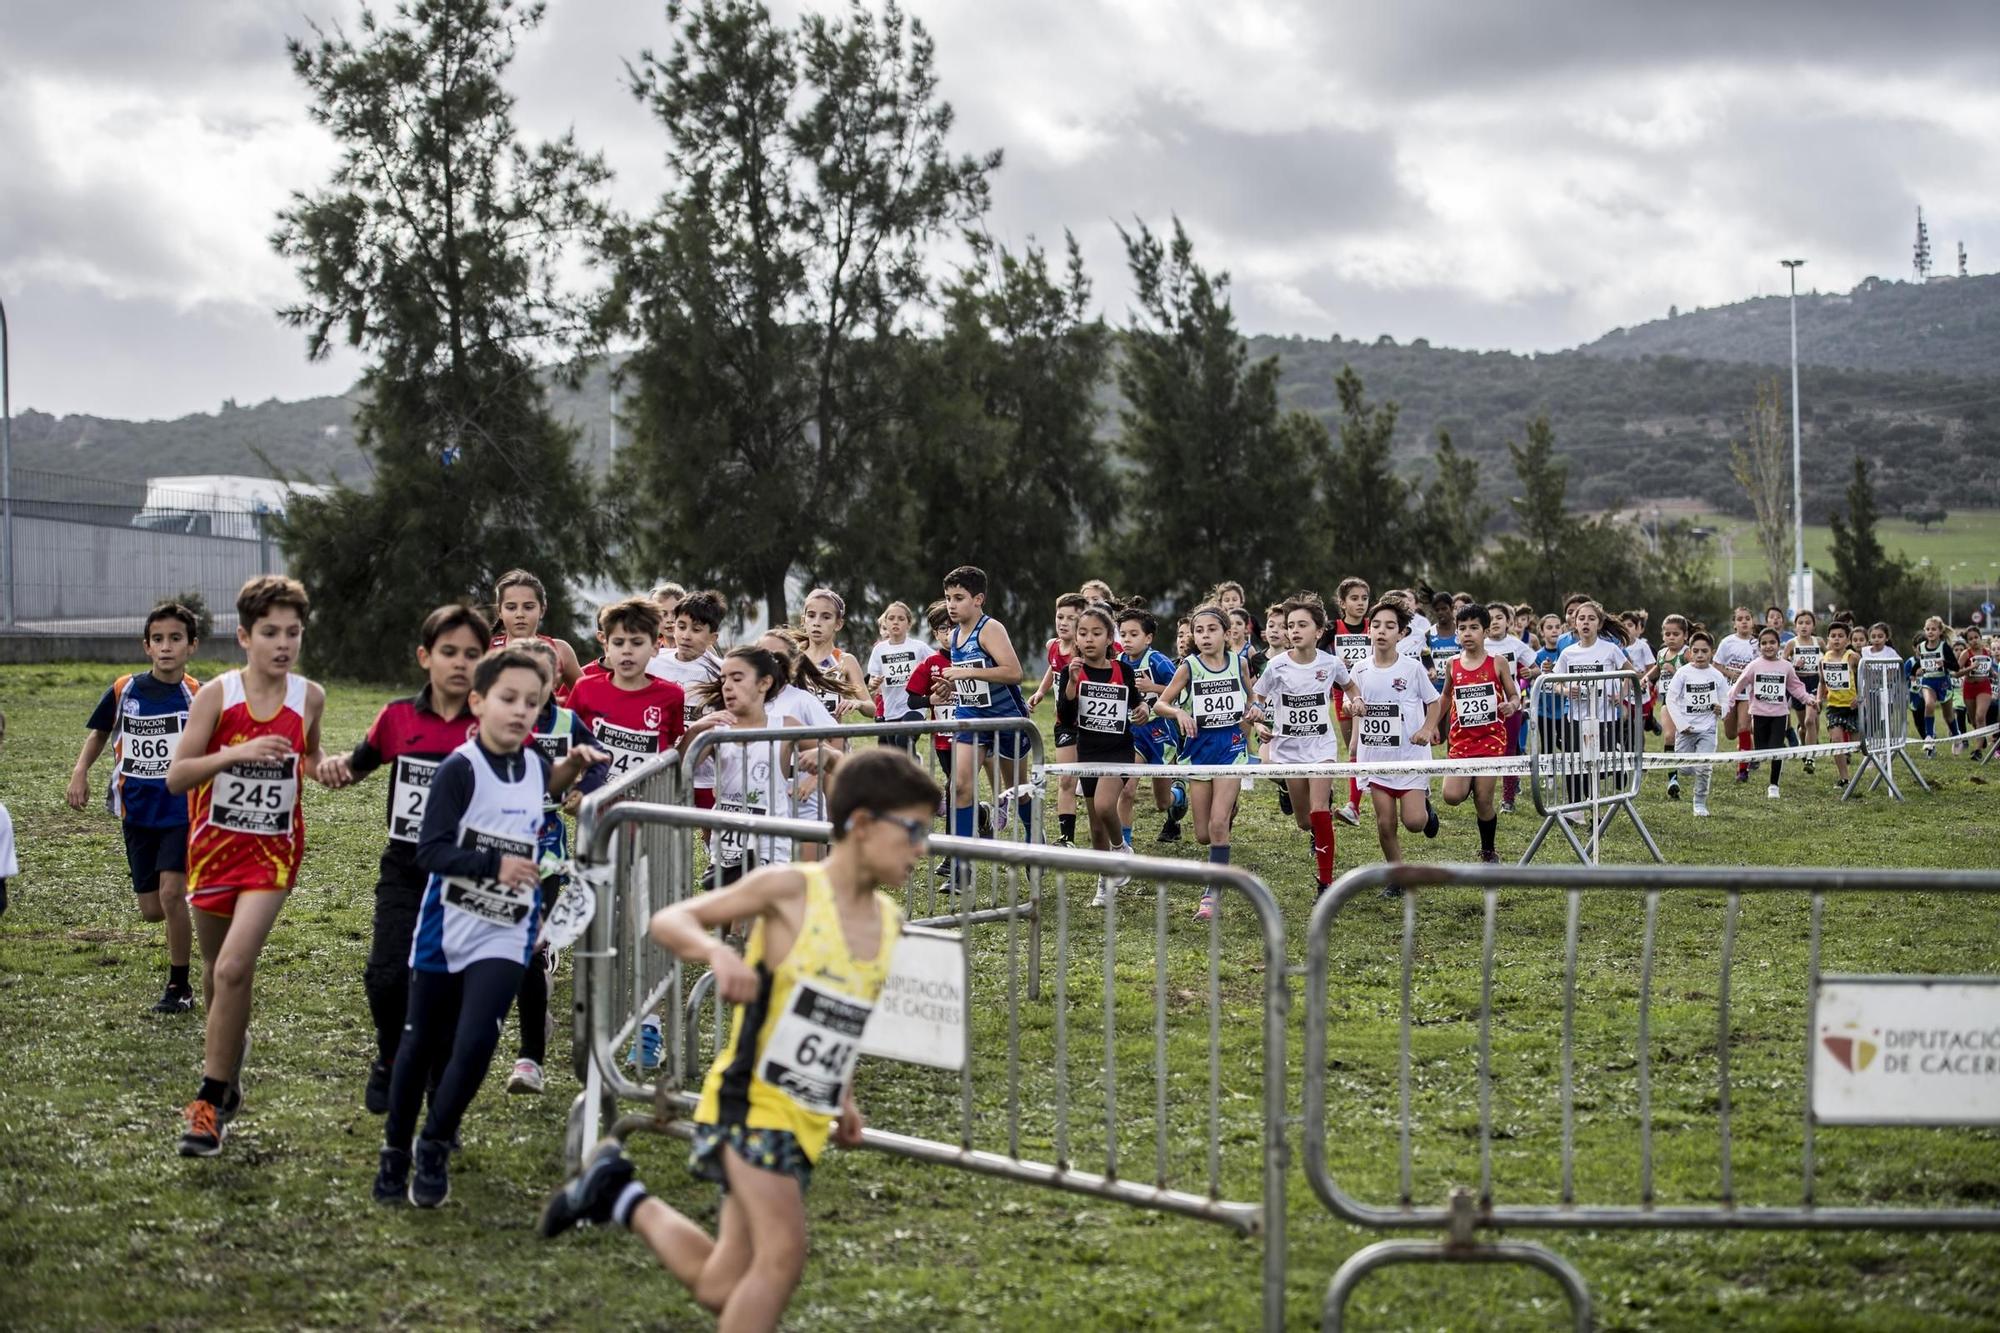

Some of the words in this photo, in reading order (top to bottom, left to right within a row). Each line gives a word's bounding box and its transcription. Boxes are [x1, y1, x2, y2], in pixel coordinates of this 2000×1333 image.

[1344, 648, 1367, 659] 223
[889, 663, 911, 676] 344
[1826, 672, 1842, 681] 651
[1760, 684, 1780, 695] 403
[1204, 695, 1234, 713] 840
[1462, 699, 1489, 714] 236
[1691, 694, 1711, 705] 351
[1086, 700, 1118, 718] 224
[128, 719, 166, 728] DIPUTACIÓN
[1289, 709, 1318, 724] 886
[1364, 719, 1390, 733] 890
[604, 727, 650, 744] DIPUTACIÓN
[131, 739, 168, 758] 866
[131, 760, 170, 770] FAEX
[232, 766, 241, 775] DE
[408, 763, 436, 777] DIPUTA
[228, 781, 282, 809] 245
[225, 809, 279, 825] FAEX
[1885, 1054, 1909, 1073] DE
